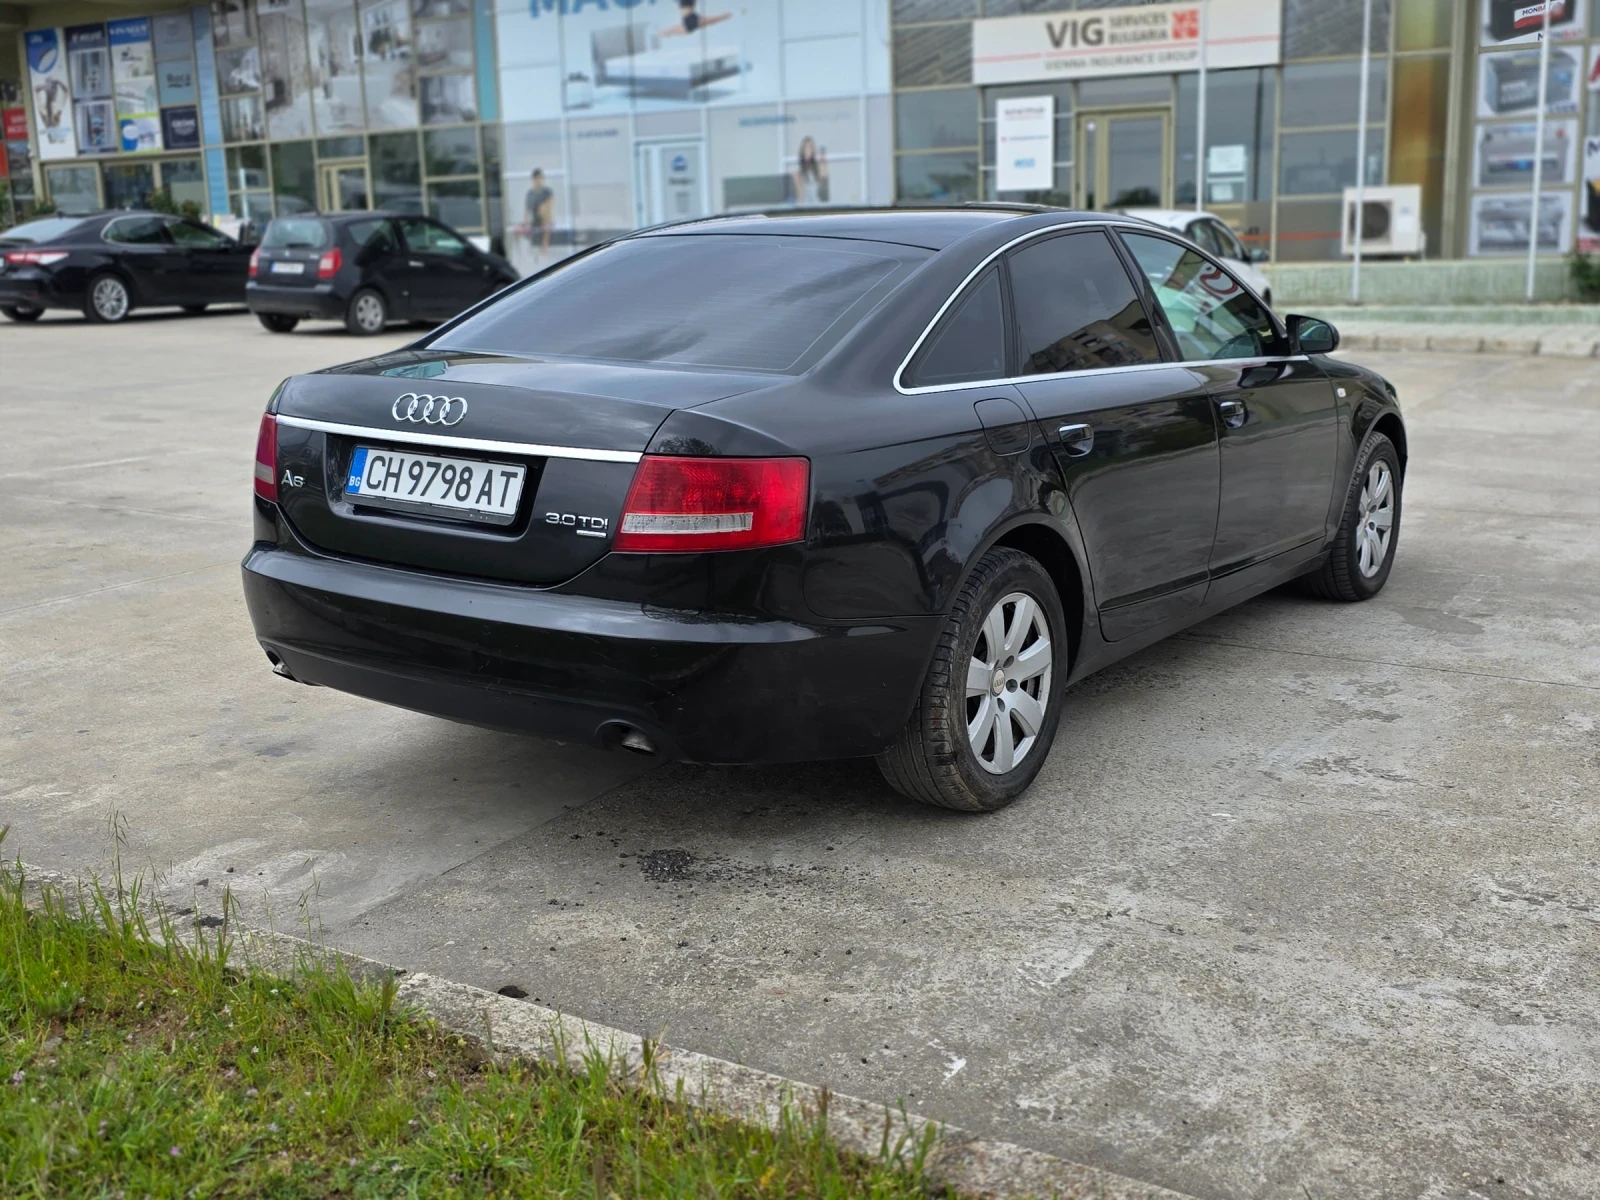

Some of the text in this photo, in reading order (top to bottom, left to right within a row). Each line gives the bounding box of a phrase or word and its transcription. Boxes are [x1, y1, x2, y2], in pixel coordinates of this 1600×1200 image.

[1109, 12, 1167, 27] SERVICES
[1046, 17, 1104, 48] VIG
[1109, 28, 1168, 44] BULGARIA
[1045, 50, 1198, 70] VIENNA INSURANCE GROUP
[281, 469, 304, 488] A6
[349, 475, 361, 487] BG
[545, 512, 609, 530] 3.0 TDI
